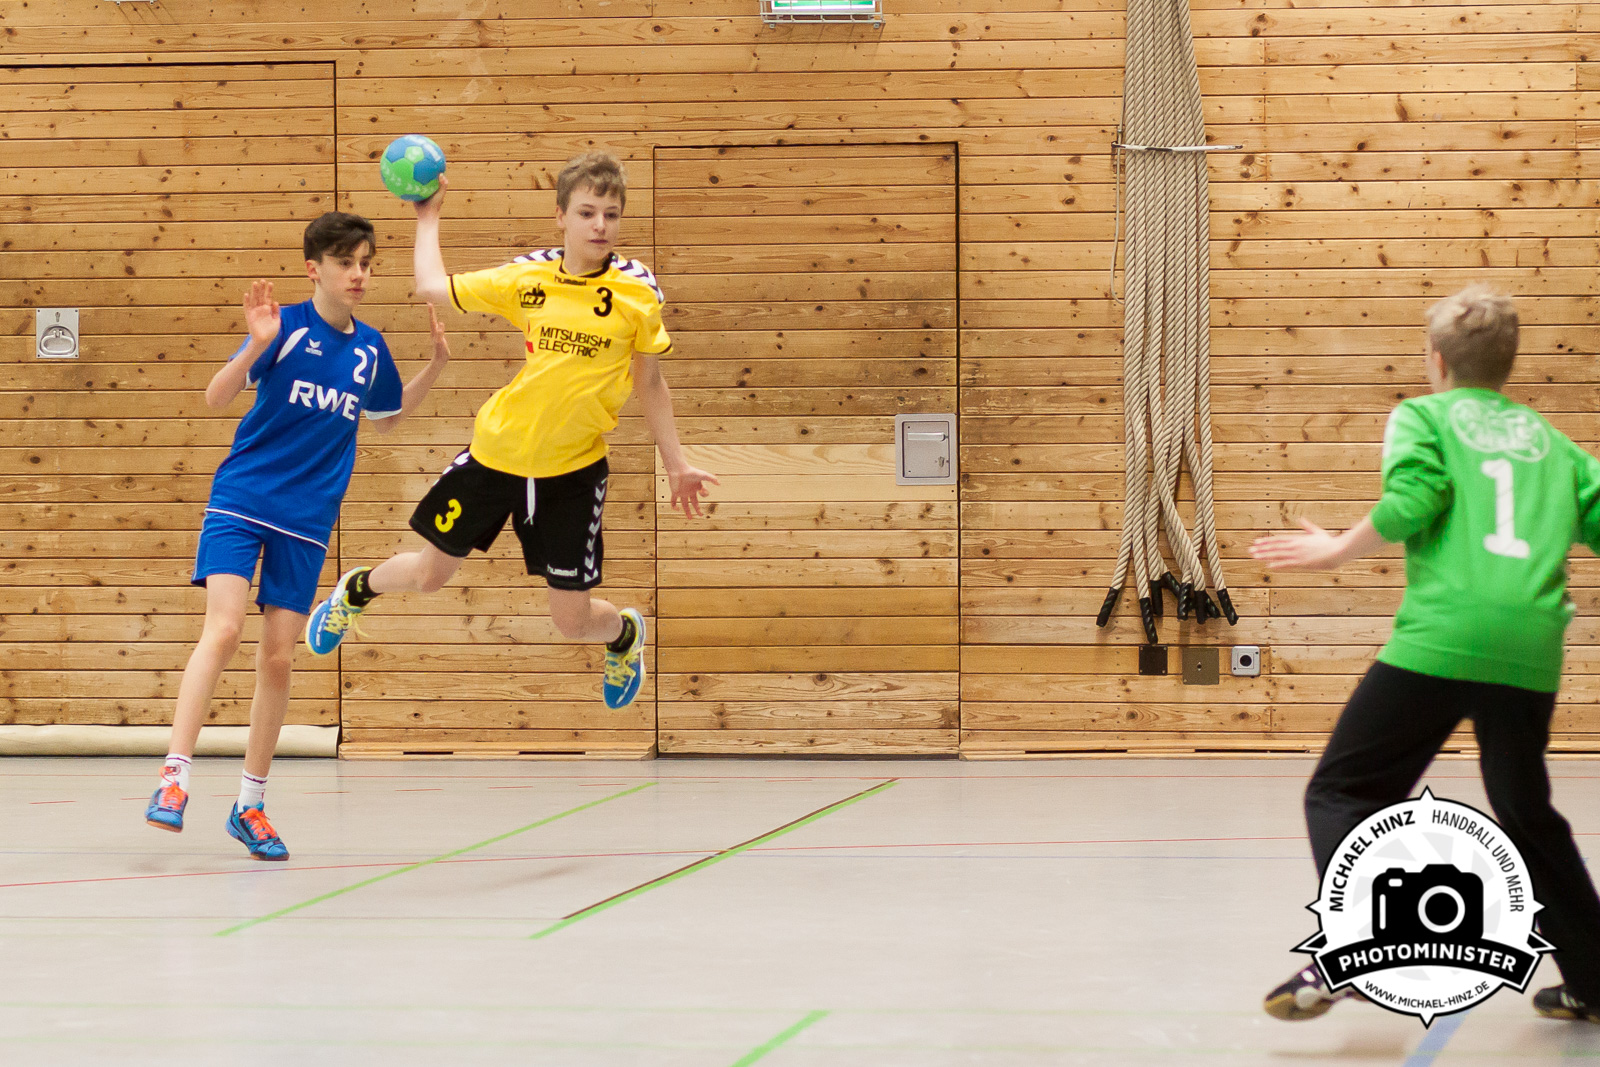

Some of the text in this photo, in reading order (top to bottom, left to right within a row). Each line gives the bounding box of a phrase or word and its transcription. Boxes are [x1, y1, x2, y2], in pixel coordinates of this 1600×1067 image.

[554, 274, 587, 286] hummel
[593, 287, 613, 317] 3
[538, 338, 599, 358] ELECTRIC
[540, 326, 612, 349] MITSUBISHI
[288, 379, 360, 421] RWE
[435, 498, 462, 533] 3
[1481, 458, 1531, 560] 1
[547, 563, 578, 577] hummel
